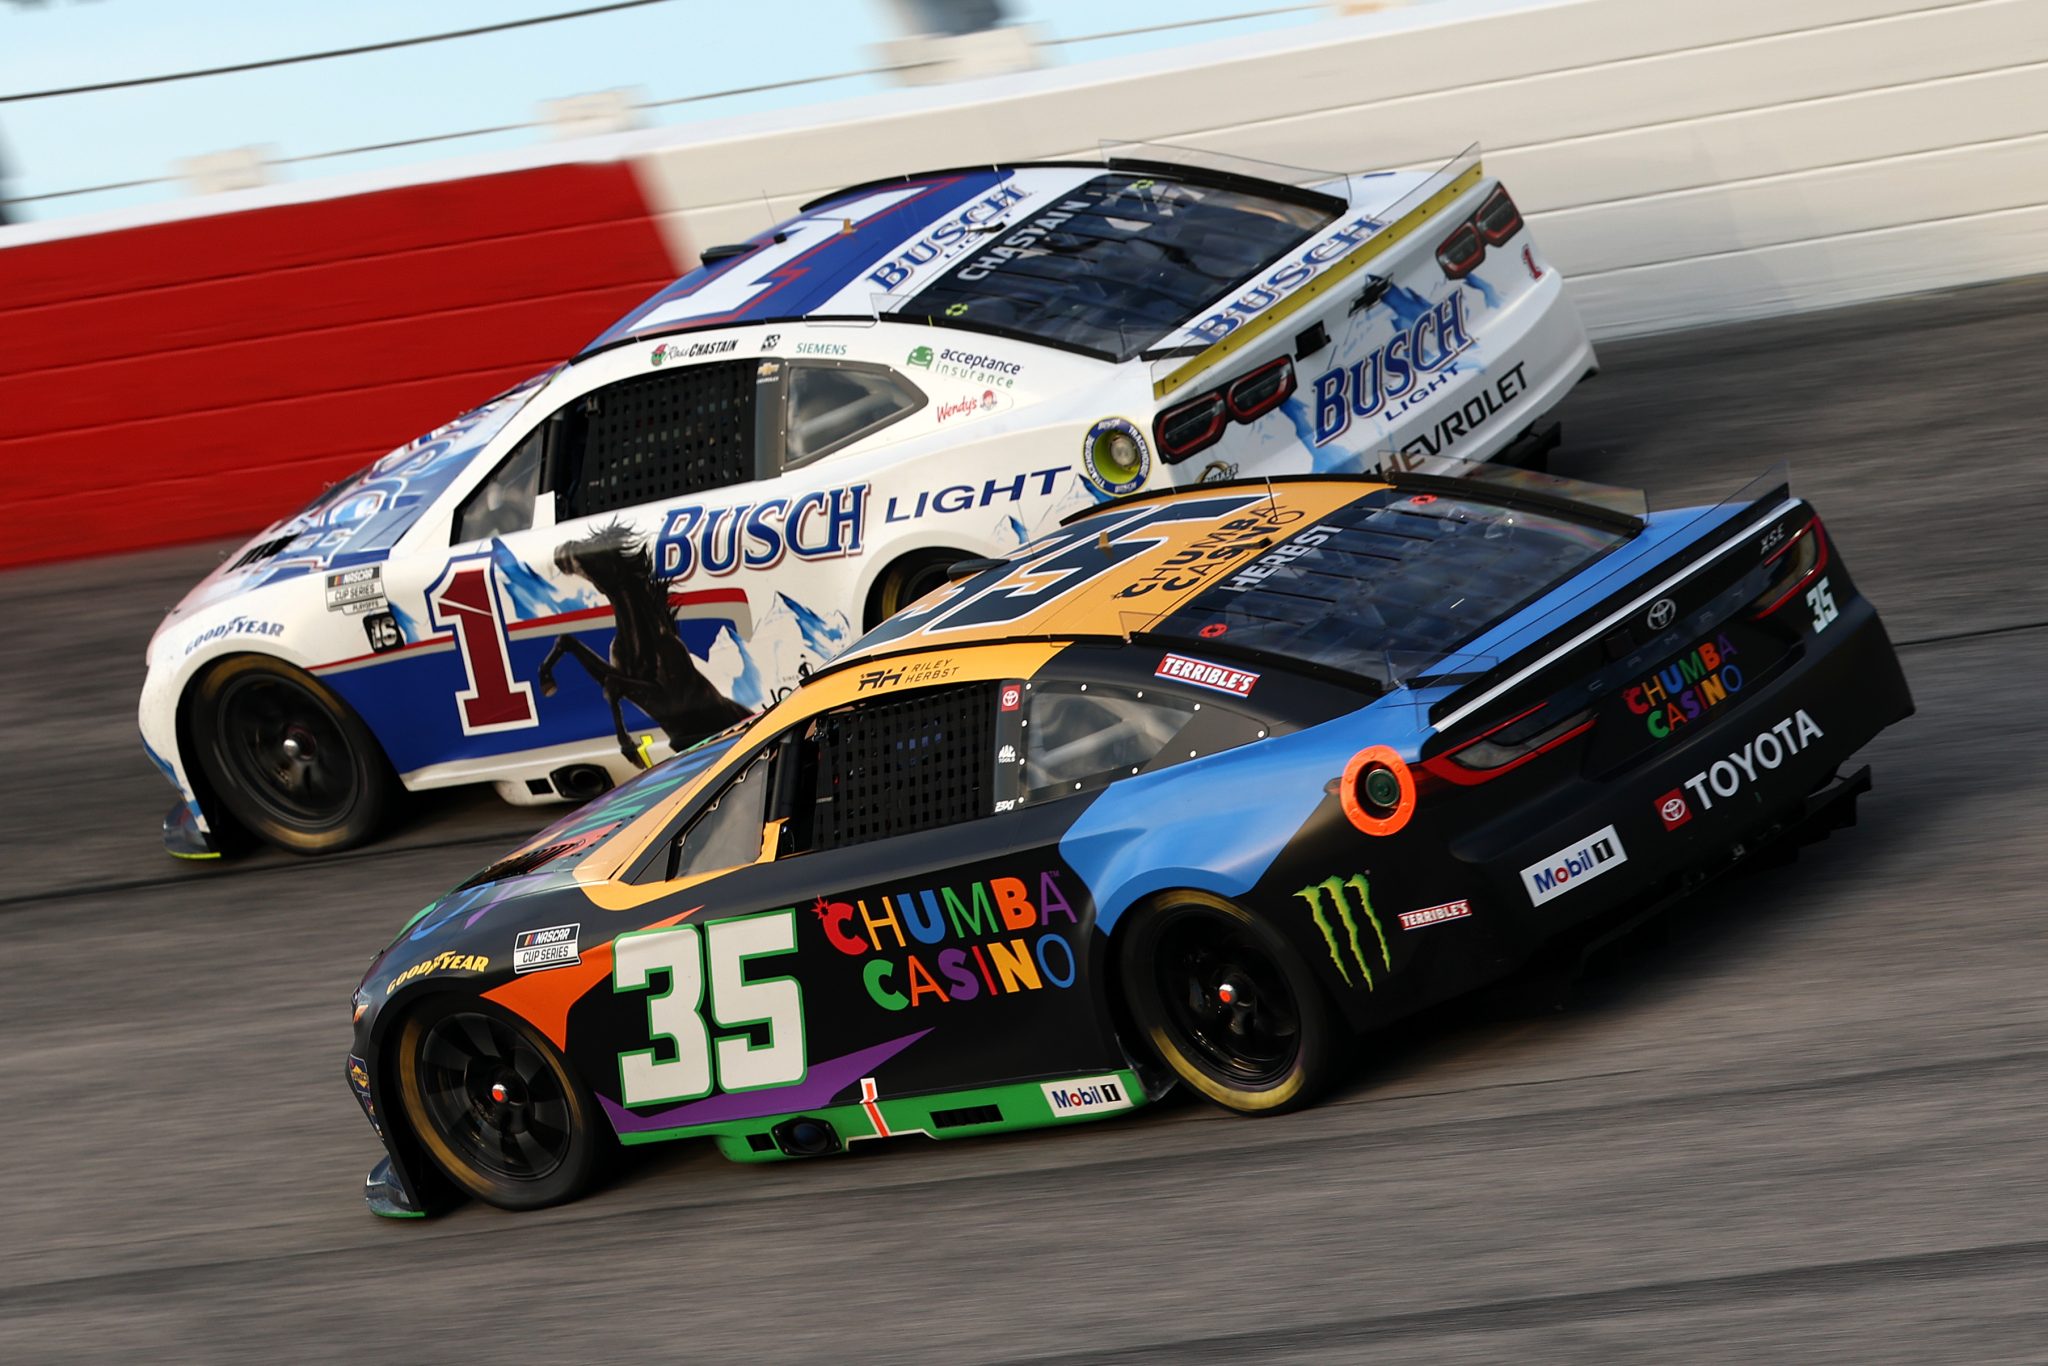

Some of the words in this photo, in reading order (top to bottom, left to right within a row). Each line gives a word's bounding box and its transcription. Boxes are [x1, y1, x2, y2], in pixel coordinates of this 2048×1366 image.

[866, 185, 1025, 293] BUSCH
[957, 200, 1092, 281] CHASTAIN
[1522, 243, 1544, 282] 1
[1184, 216, 1386, 344] BUSCH
[689, 339, 738, 357] CHASTAIN
[796, 342, 848, 356] SIEMENS
[936, 361, 1014, 389] insurance
[940, 348, 1021, 376] acceptance
[1311, 287, 1474, 449] BUSCH
[936, 395, 978, 423] Wendy's
[1362, 360, 1529, 475] HEVROLET
[1385, 362, 1459, 422] LIGHT
[885, 465, 1072, 524] LIGHT
[655, 481, 872, 582] BUSCH
[1114, 505, 1286, 599] CHUMBA
[1219, 524, 1343, 593] HERBST
[1759, 522, 1786, 555] XSE
[334, 589, 350, 601] CUP
[350, 584, 375, 598] SERIES
[343, 567, 374, 585] NASCAR
[1805, 576, 1840, 635] 35
[184, 616, 285, 656] GOODYEAR
[427, 553, 540, 737] 1
[904, 666, 961, 685] HERBST
[911, 658, 953, 673] RILEY
[1161, 656, 1255, 692] TERRIBLE'S
[1623, 632, 1739, 715] CHUMBA
[1646, 663, 1743, 739] CASINO
[1684, 709, 1825, 811] TOYOTA
[1533, 848, 1594, 894] Mobil
[1593, 840, 1611, 862] 1
[535, 928, 571, 945] NASCAR
[820, 872, 1078, 956] CHUMBA
[1401, 901, 1469, 928] TERRIBLE'S
[386, 950, 490, 996] GOODYEAR
[522, 949, 540, 964] CUP
[540, 946, 569, 960] SERIES
[862, 932, 1077, 1011] CASINO
[611, 907, 809, 1110] 35
[1051, 1085, 1103, 1109] Mobil
[1103, 1084, 1118, 1102] 1
